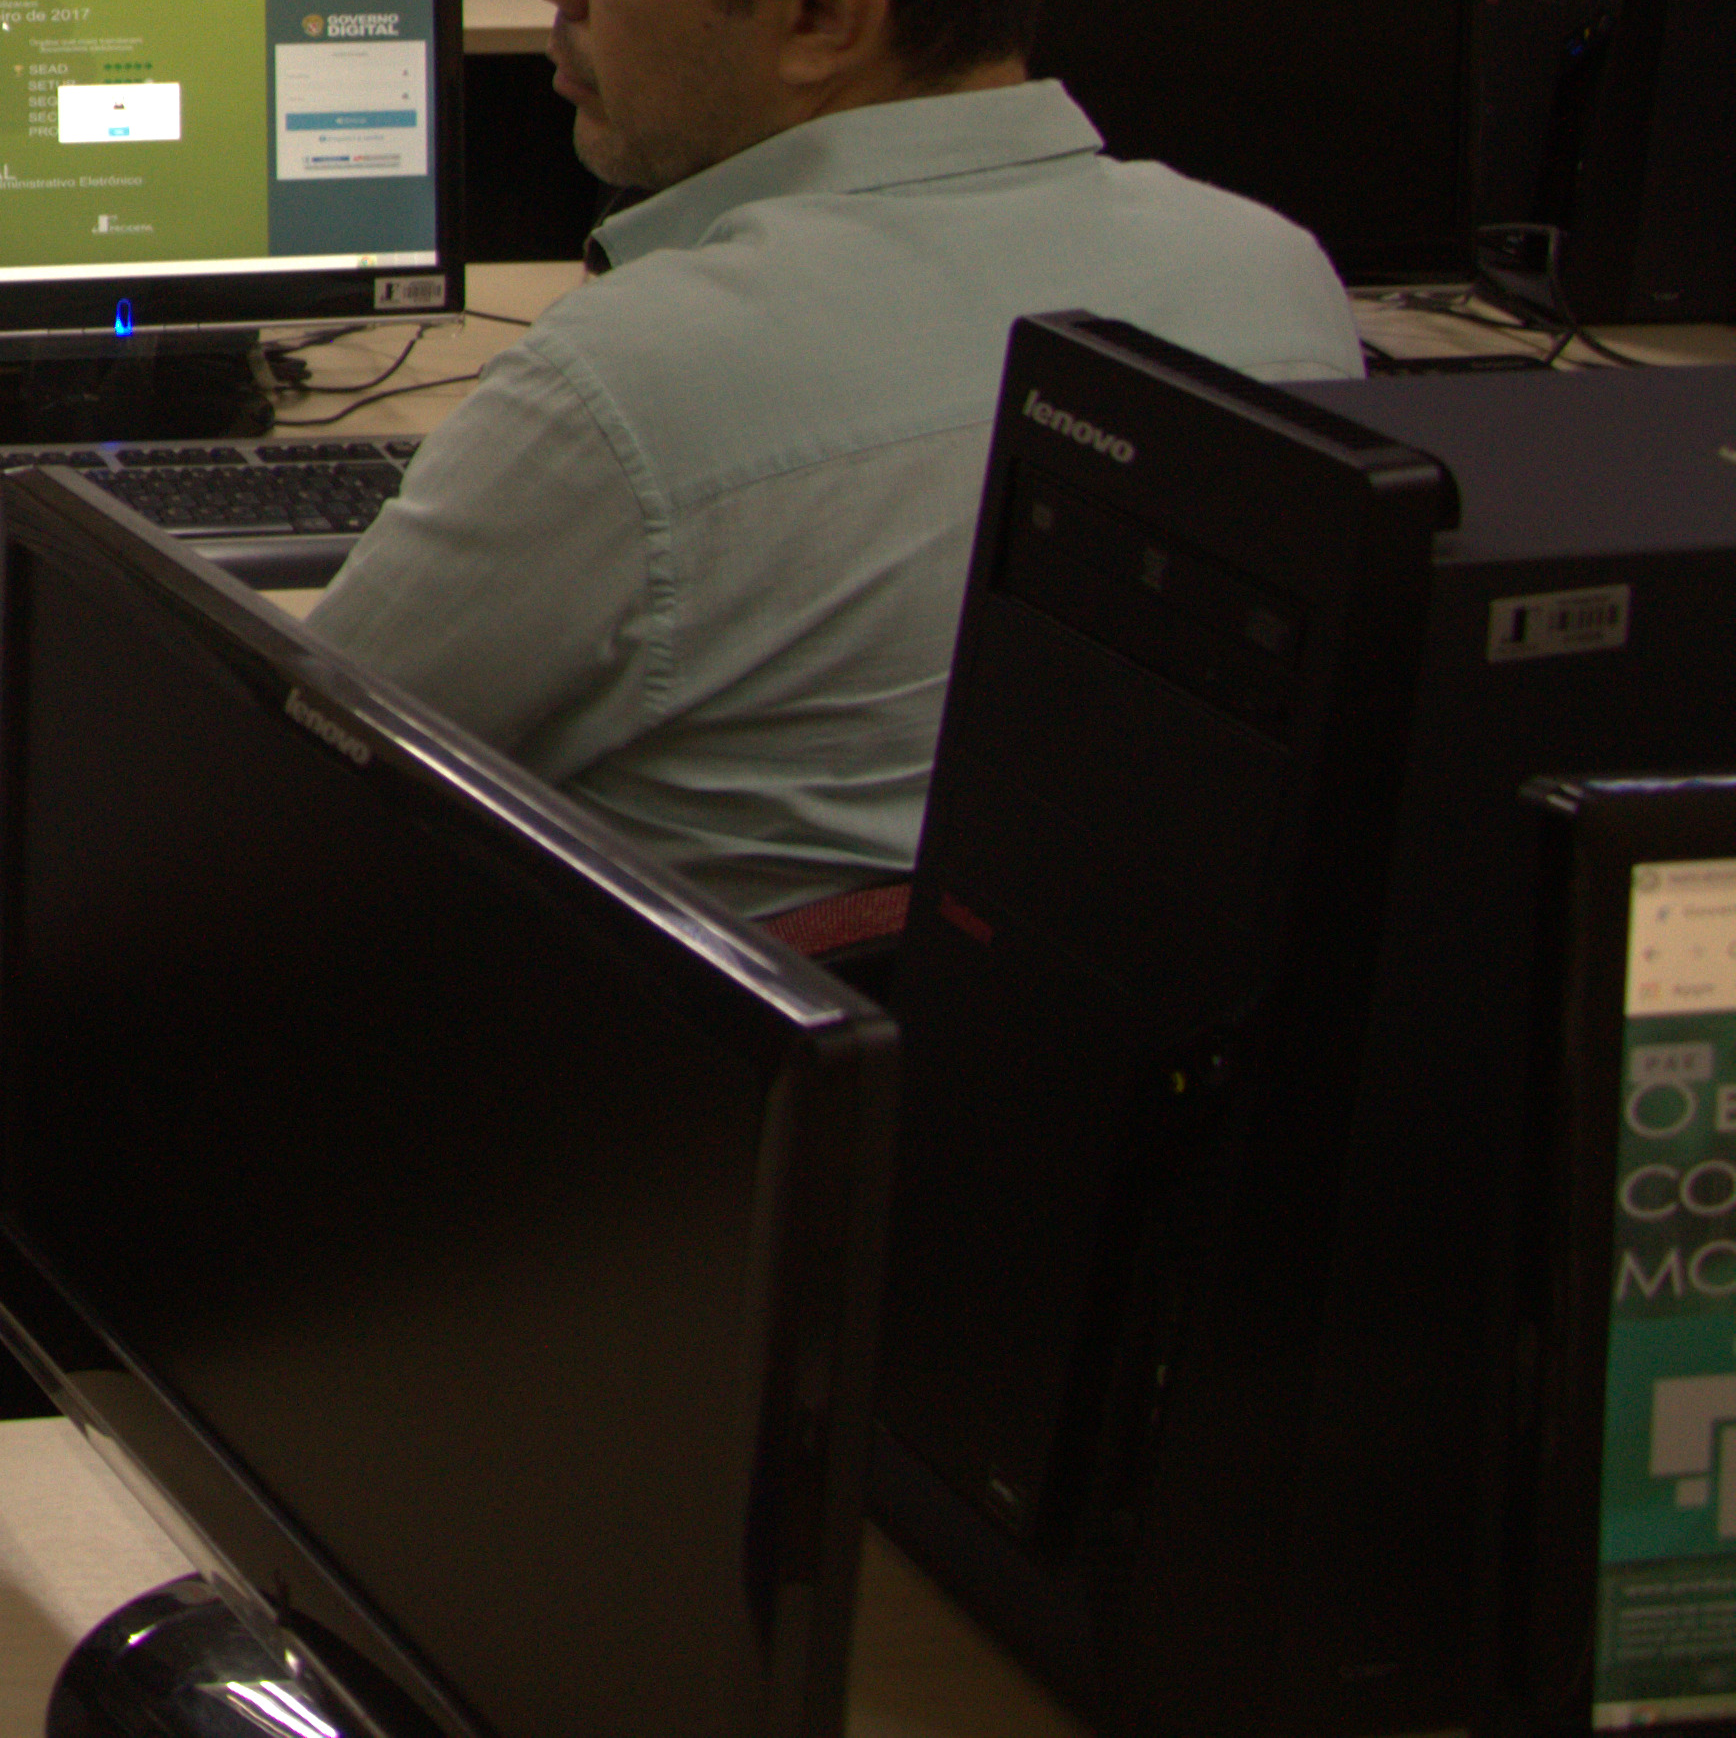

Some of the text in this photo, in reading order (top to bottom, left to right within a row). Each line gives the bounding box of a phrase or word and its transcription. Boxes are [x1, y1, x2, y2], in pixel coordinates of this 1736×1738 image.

[26, 10, 46, 22] de
[50, 8, 91, 22] 2017
[327, 14, 399, 26] GOVERNO
[327, 24, 399, 37] DIGITAL
[29, 64, 69, 75] SEAD
[80, 174, 143, 187] Eletrônico
[1022, 389, 1135, 462] lenovo
[285, 688, 370, 765] lenovo
[1628, 1081, 1697, 1139] O
